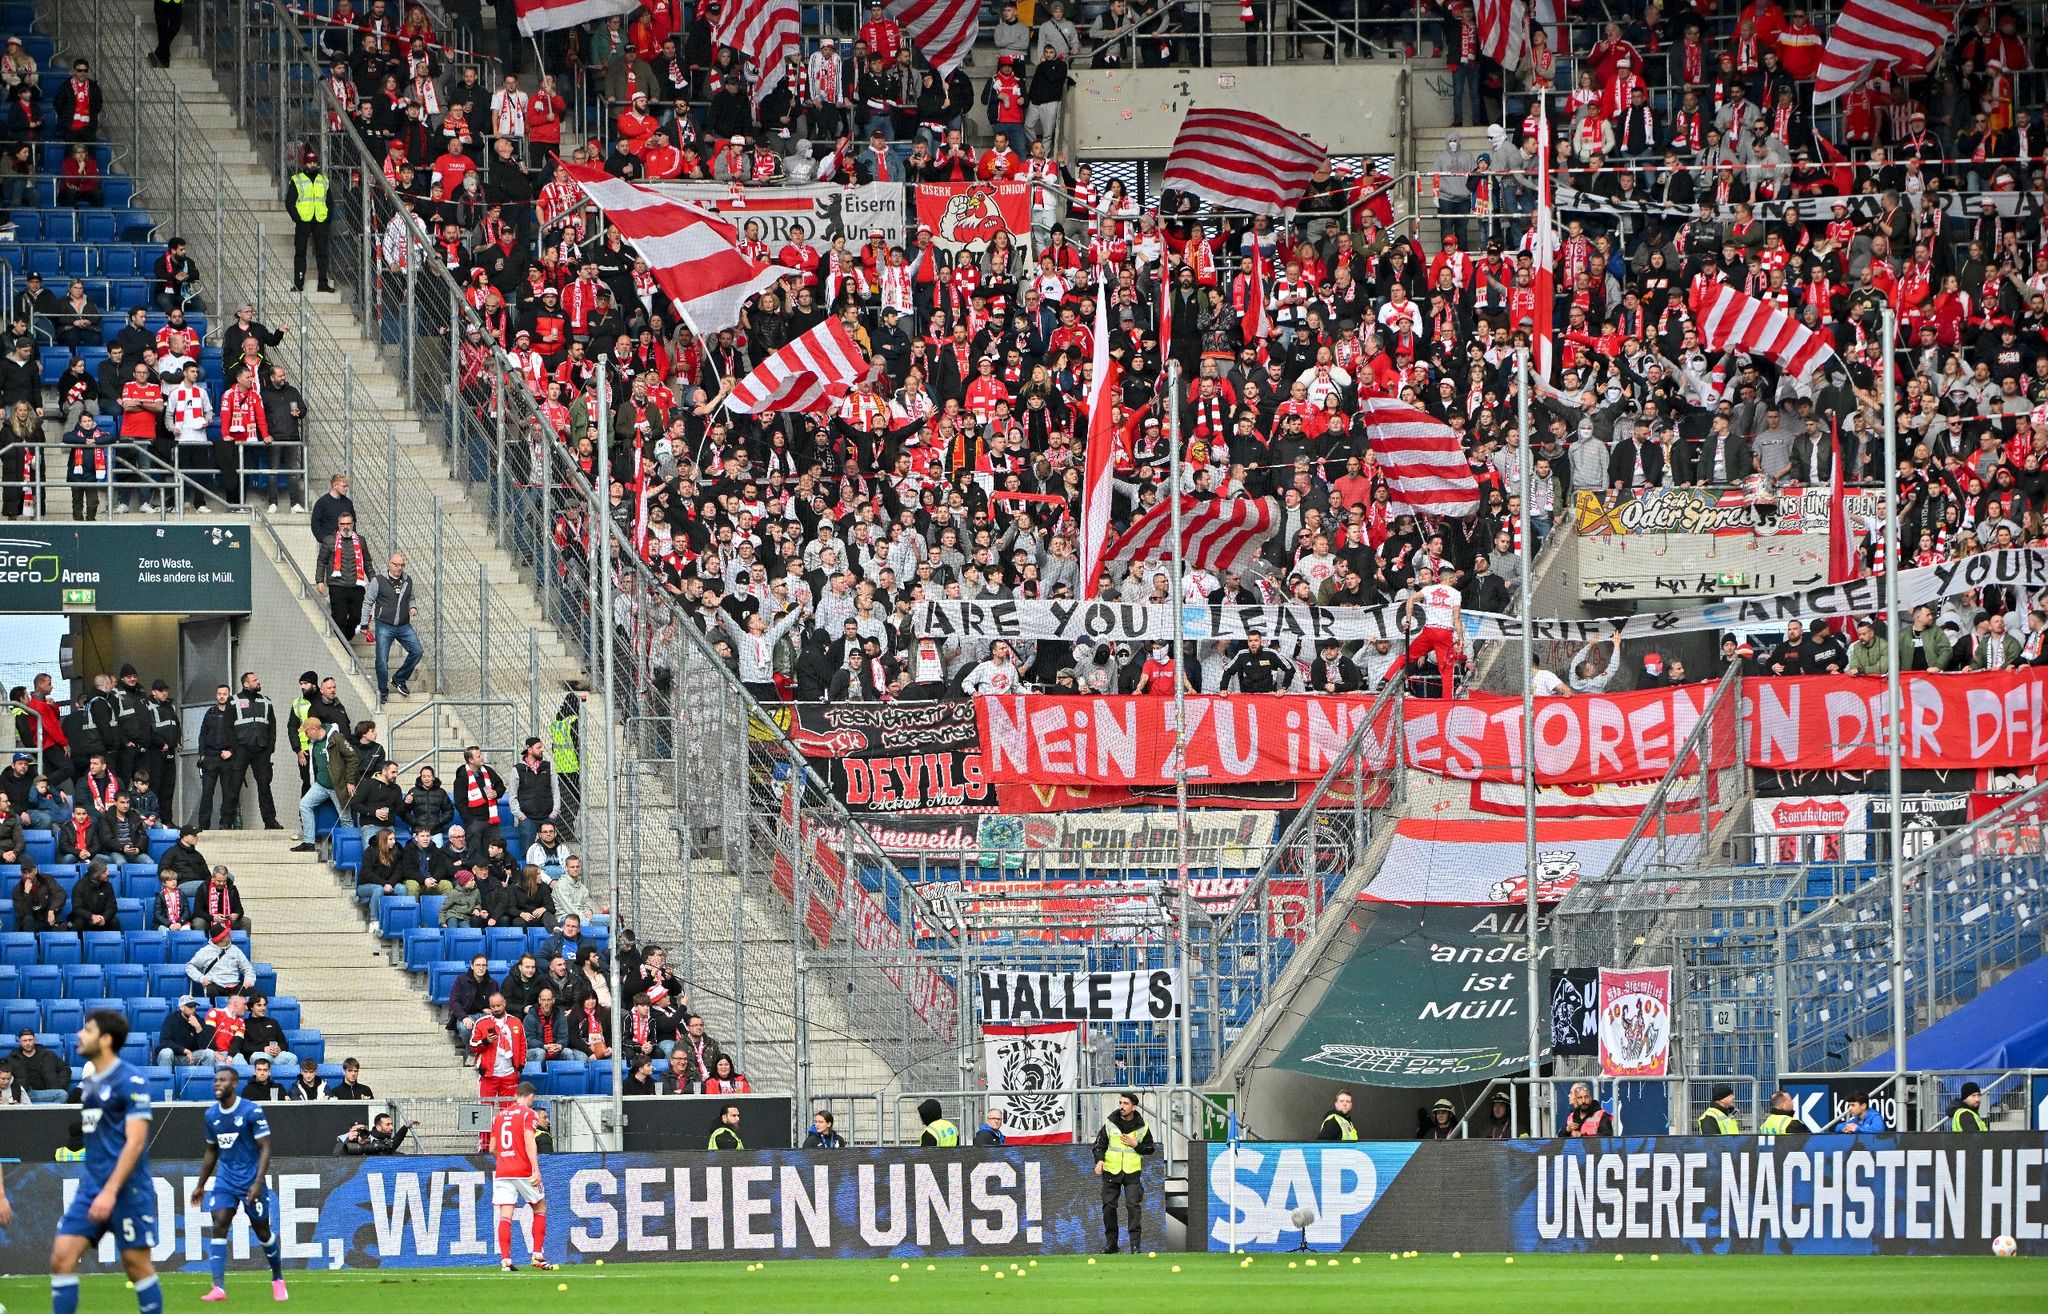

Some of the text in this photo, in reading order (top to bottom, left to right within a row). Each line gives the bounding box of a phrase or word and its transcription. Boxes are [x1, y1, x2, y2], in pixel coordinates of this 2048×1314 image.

[920, 183, 1026, 196] EISERN UNION
[846, 197, 896, 213] Eisern
[138, 557, 193, 569] Zero Waste.
[62, 569, 100, 583] Arena
[138, 571, 235, 583] Alles andere ist Müll.
[925, 601, 1020, 636] ARE
[1050, 600, 1148, 637] YOU
[1364, 601, 1428, 638] TO
[1653, 611, 1680, 630] &
[1935, 550, 2048, 595] YOUR
[1160, 698, 1259, 778] ZU
[1825, 677, 1944, 763] DER
[1966, 680, 2048, 761] DFL
[843, 753, 988, 804] DEVILS
[1922, 798, 1968, 814] UNIONER
[1462, 972, 1515, 992] ist
[981, 970, 1181, 1019] HALLE / S.
[1418, 998, 1517, 1020] Müll.
[1718, 1011, 1729, 1025] G2
[997, 1039, 1068, 1060] SIXTY
[471, 1111, 479, 1125] F
[501, 1120, 513, 1149] 6
[1210, 1147, 1378, 1245] SAP
[1537, 1135, 2048, 1240] UNSERE NÄCHSTEN HE
[255, 1200, 264, 1217] 9
[570, 1164, 831, 1253] SEHEN
[858, 1160, 1043, 1249] UNS!
[122, 1217, 136, 1242] 5
